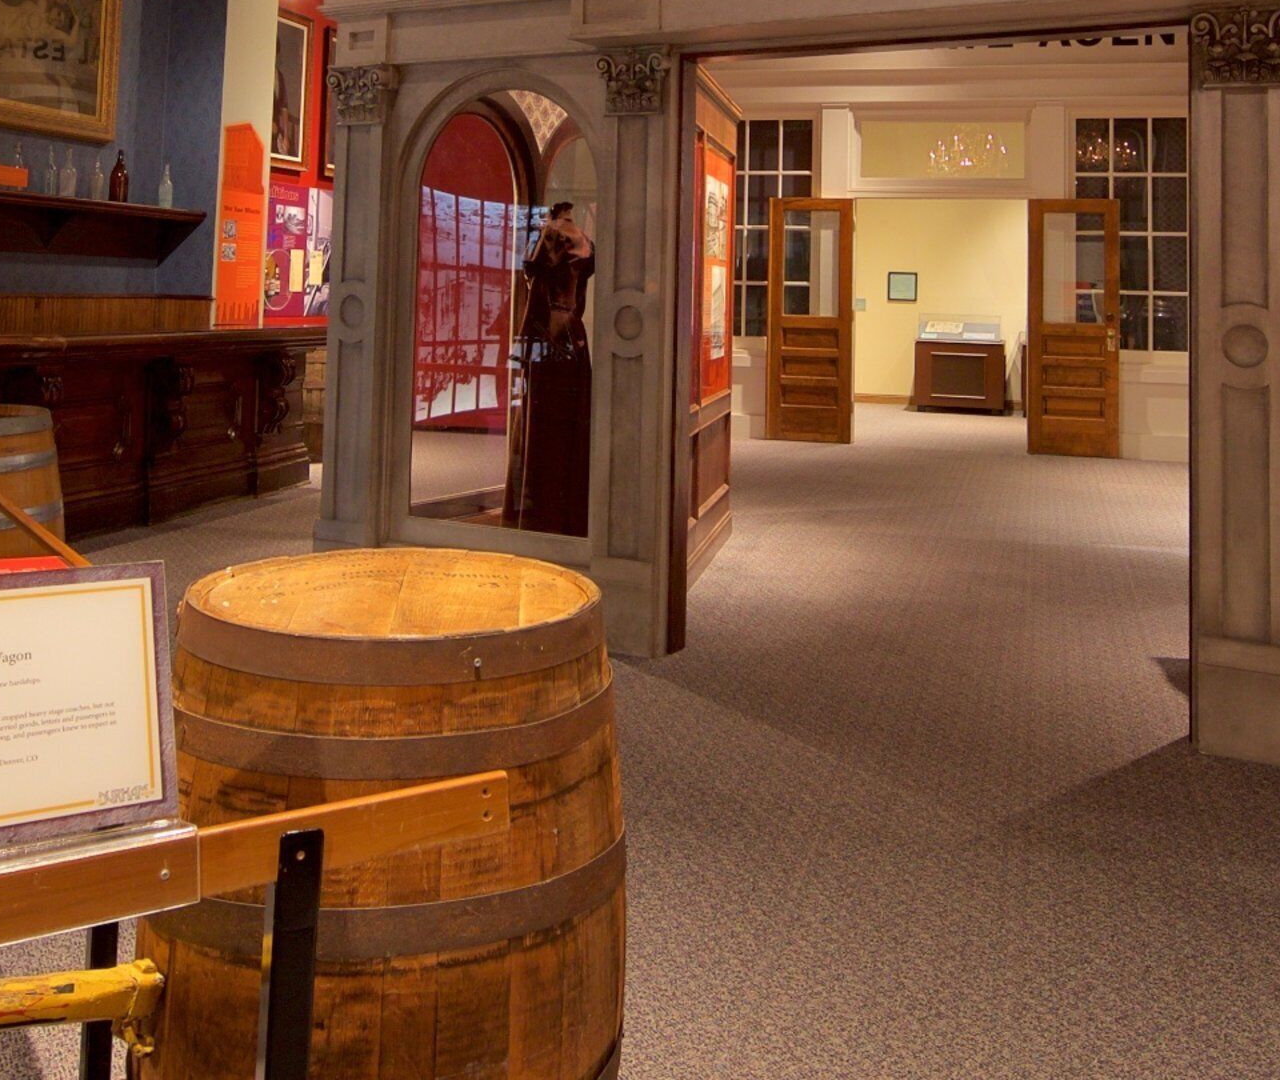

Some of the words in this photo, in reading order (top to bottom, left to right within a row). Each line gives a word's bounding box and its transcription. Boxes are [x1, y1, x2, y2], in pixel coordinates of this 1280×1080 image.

[1, 712, 27, 721] stopped
[48, 708, 63, 716] stage
[75, 712, 107, 722] passengers
[26, 728, 60, 738] passengers
[88, 720, 108, 729] expect
